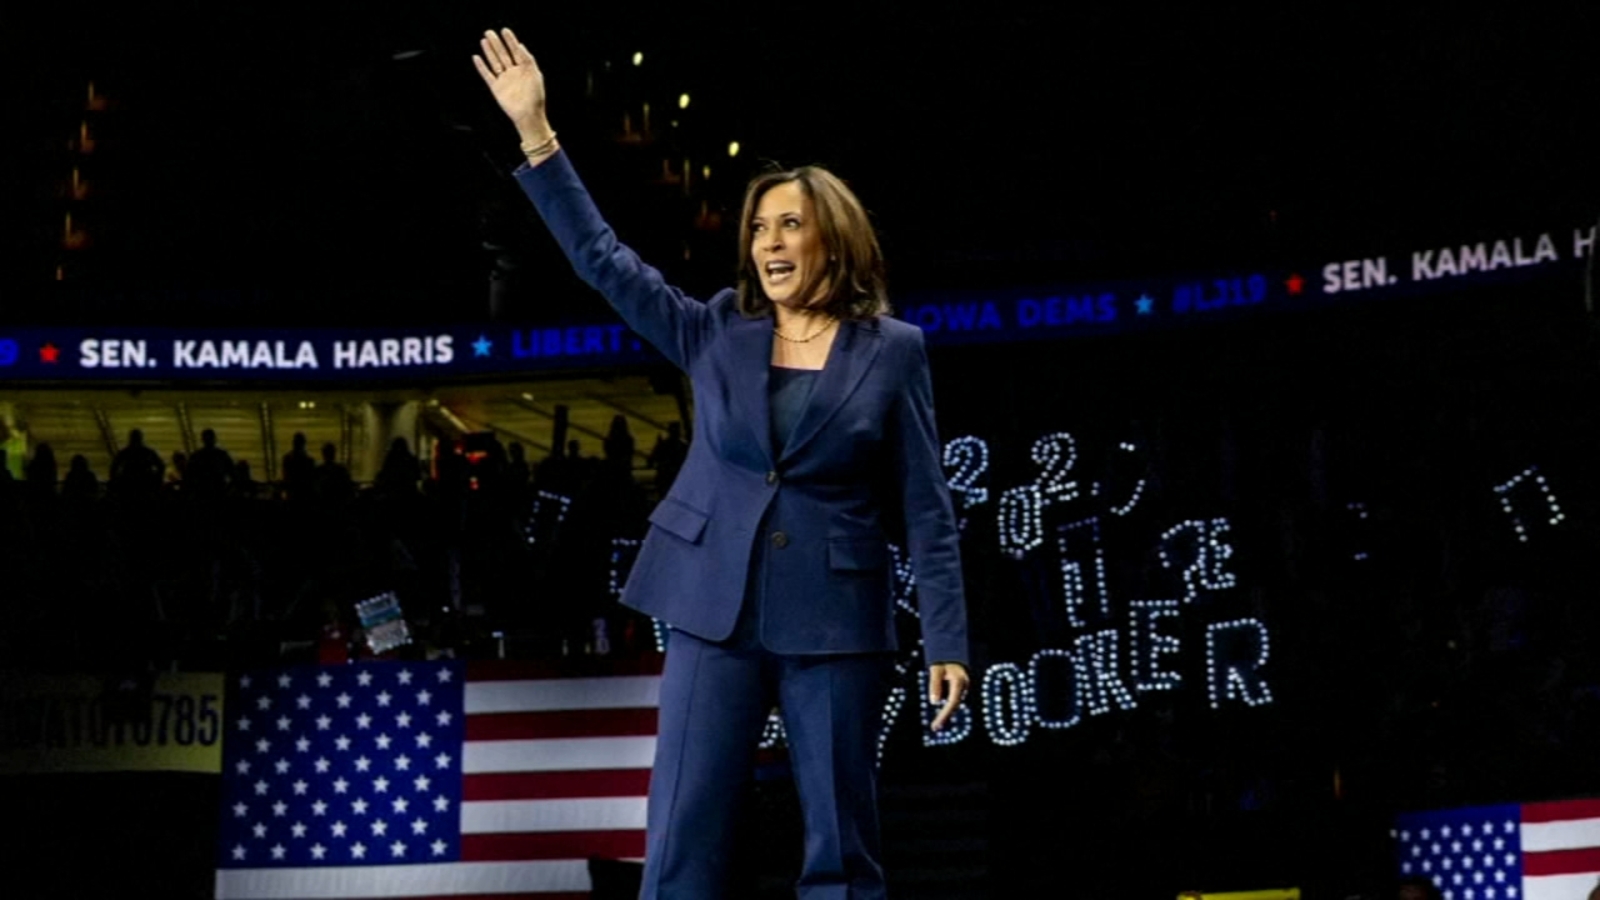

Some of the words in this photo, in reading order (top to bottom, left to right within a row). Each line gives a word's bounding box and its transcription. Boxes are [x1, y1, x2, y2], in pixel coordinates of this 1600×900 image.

[1322, 256, 1398, 294] SEN.
[1412, 233, 1558, 282] KAMALA
[1017, 292, 1118, 327] DEMS
[1172, 273, 1267, 312] #LJ19
[79, 338, 157, 369] SEN.
[173, 339, 318, 369] KAMALA
[333, 334, 454, 369] HARRIS
